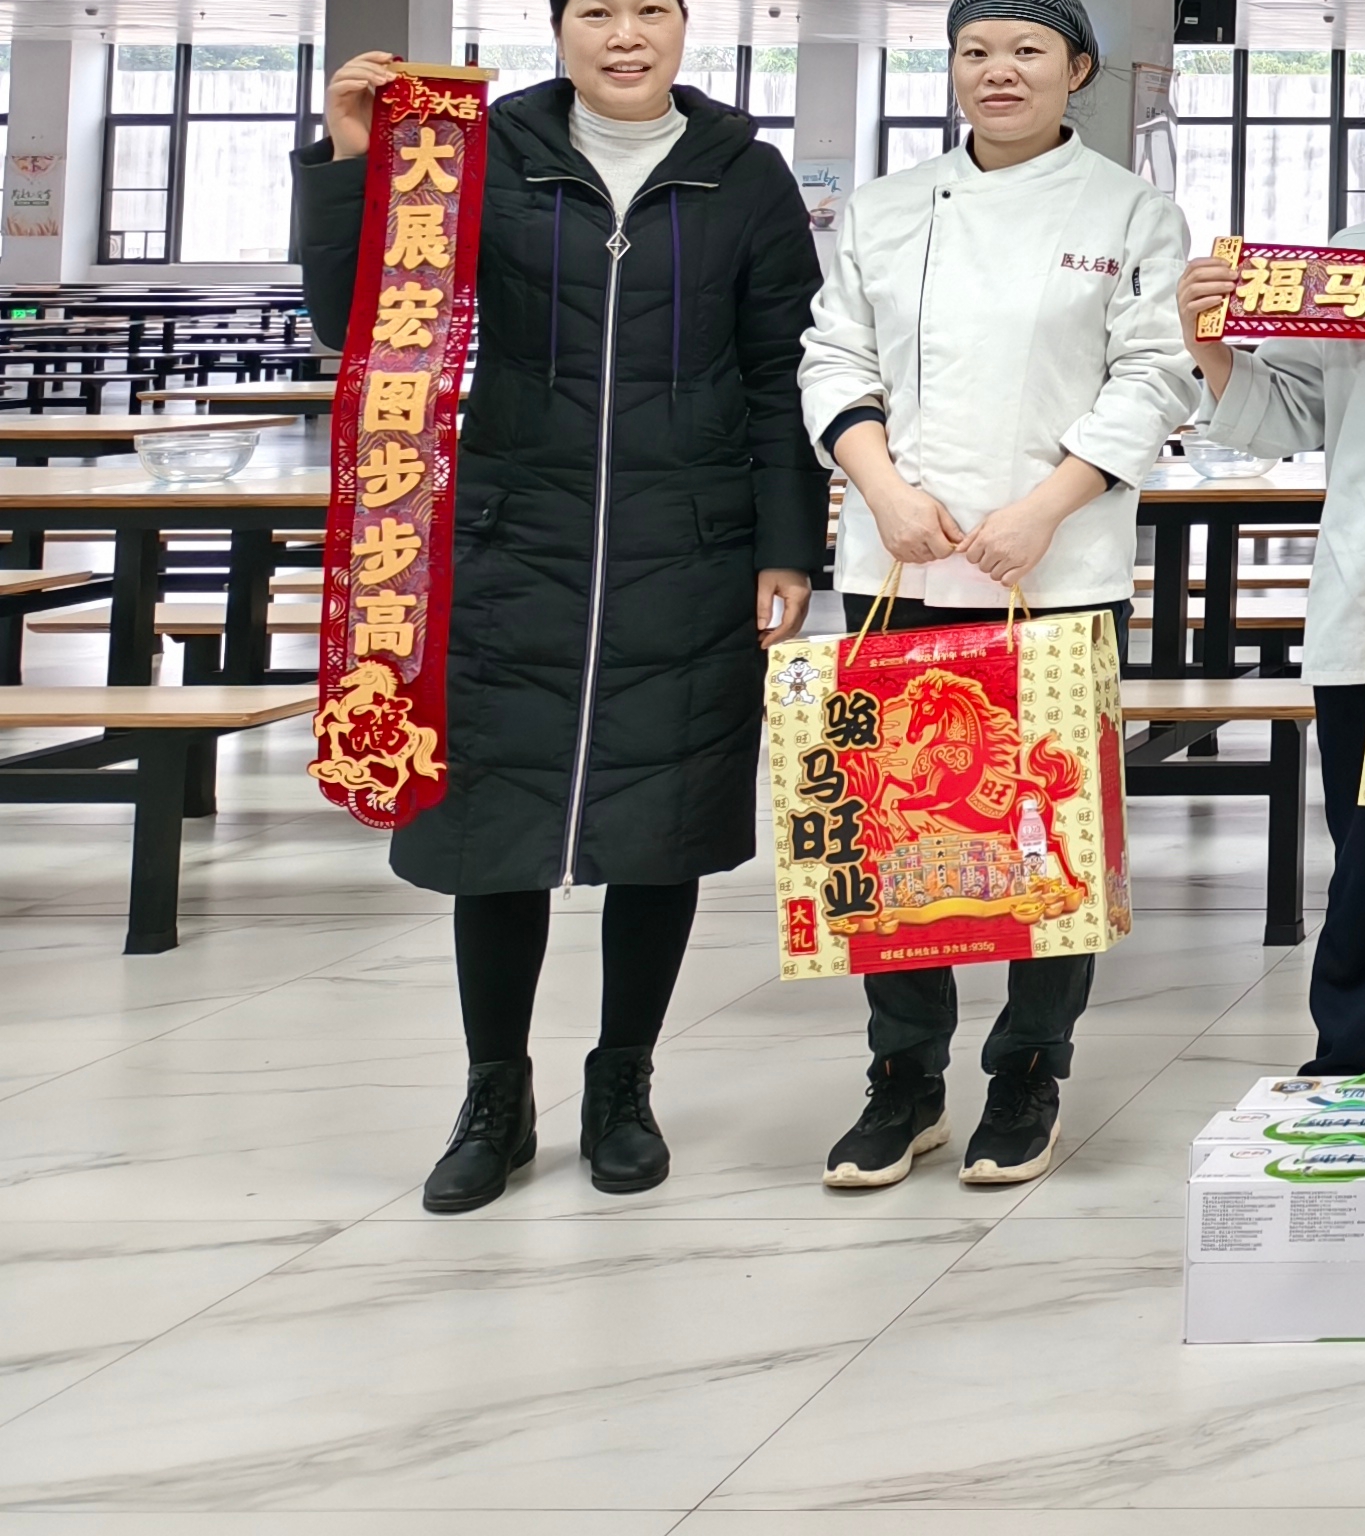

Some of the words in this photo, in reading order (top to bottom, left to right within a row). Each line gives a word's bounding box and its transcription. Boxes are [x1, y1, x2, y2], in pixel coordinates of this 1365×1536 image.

[1061, 252, 1119, 276] 医大后勤
[355, 127, 459, 657] 大展宏图步步高
[790, 692, 878, 917] 骏马旺业
[981, 780, 1008, 806] 旺
[791, 905, 815, 949] 大礼
